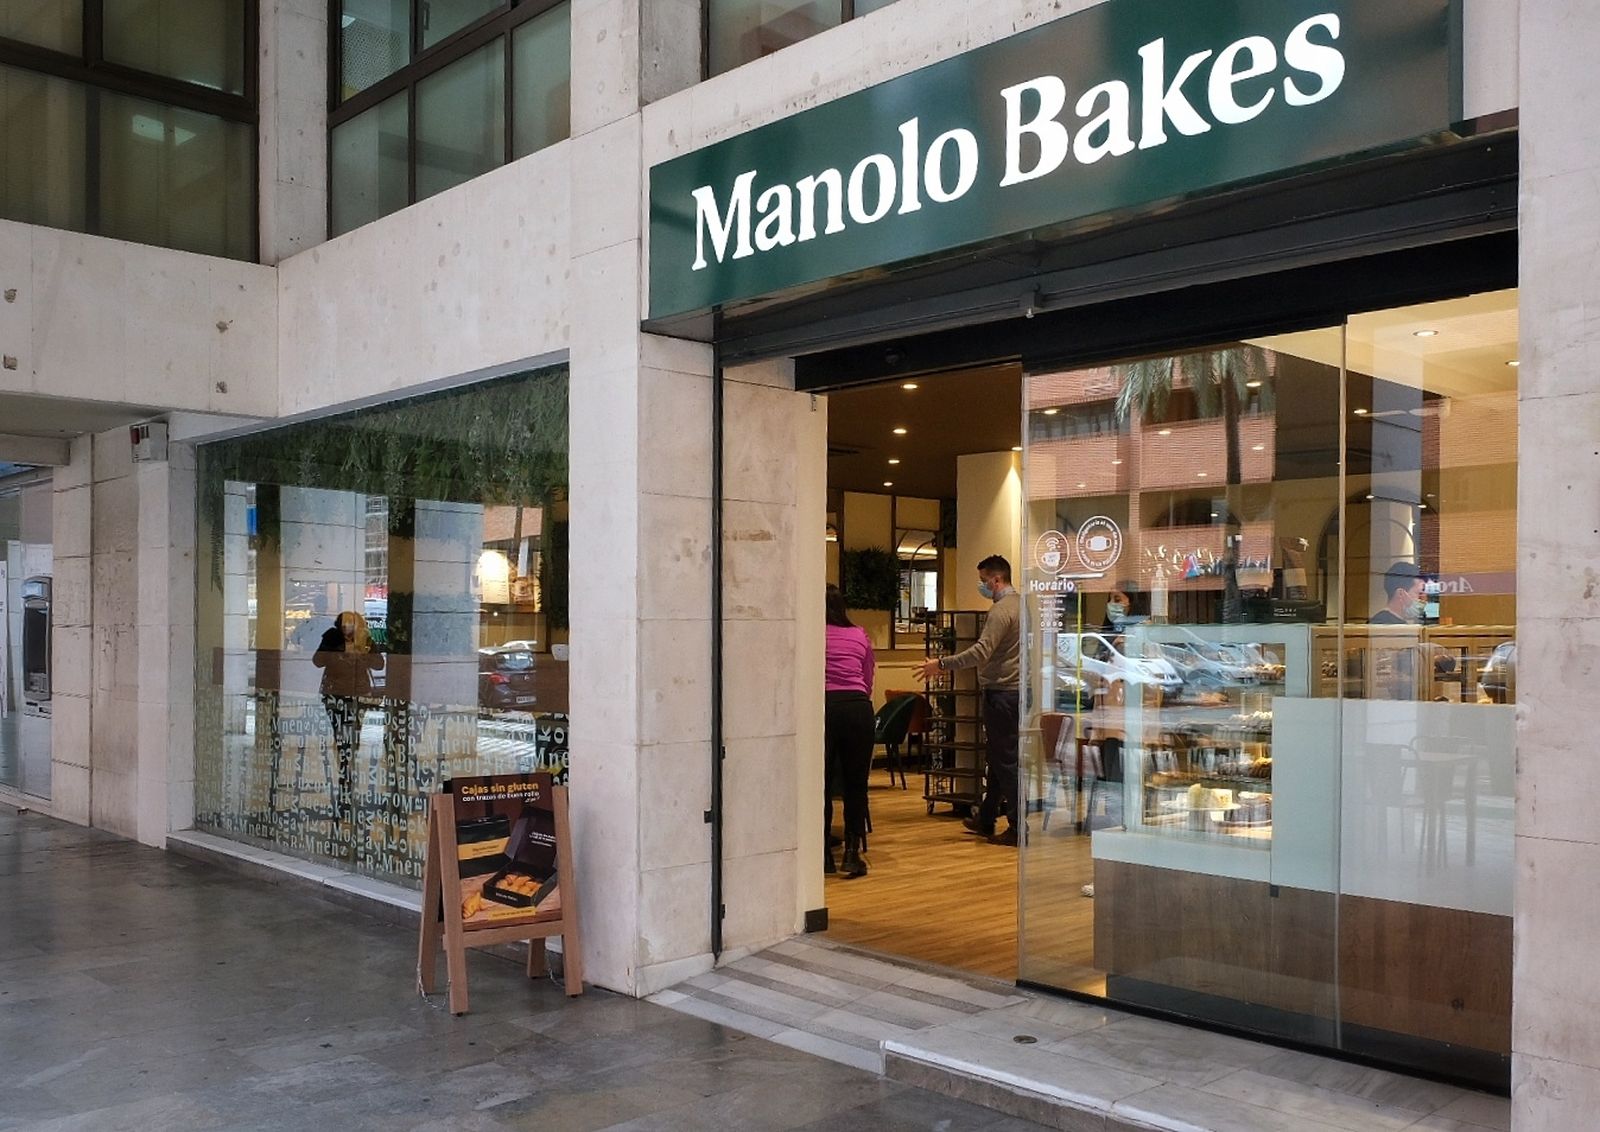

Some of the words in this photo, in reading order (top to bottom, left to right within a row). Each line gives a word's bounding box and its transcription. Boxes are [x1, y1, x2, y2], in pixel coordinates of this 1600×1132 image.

[691, 116, 979, 271] Manolo
[999, 13, 1346, 187] Bakes
[1029, 578, 1075, 592] Horario
[461, 784, 489, 796] Cajas
[490, 783, 506, 792] sin
[507, 782, 539, 793] gluten
